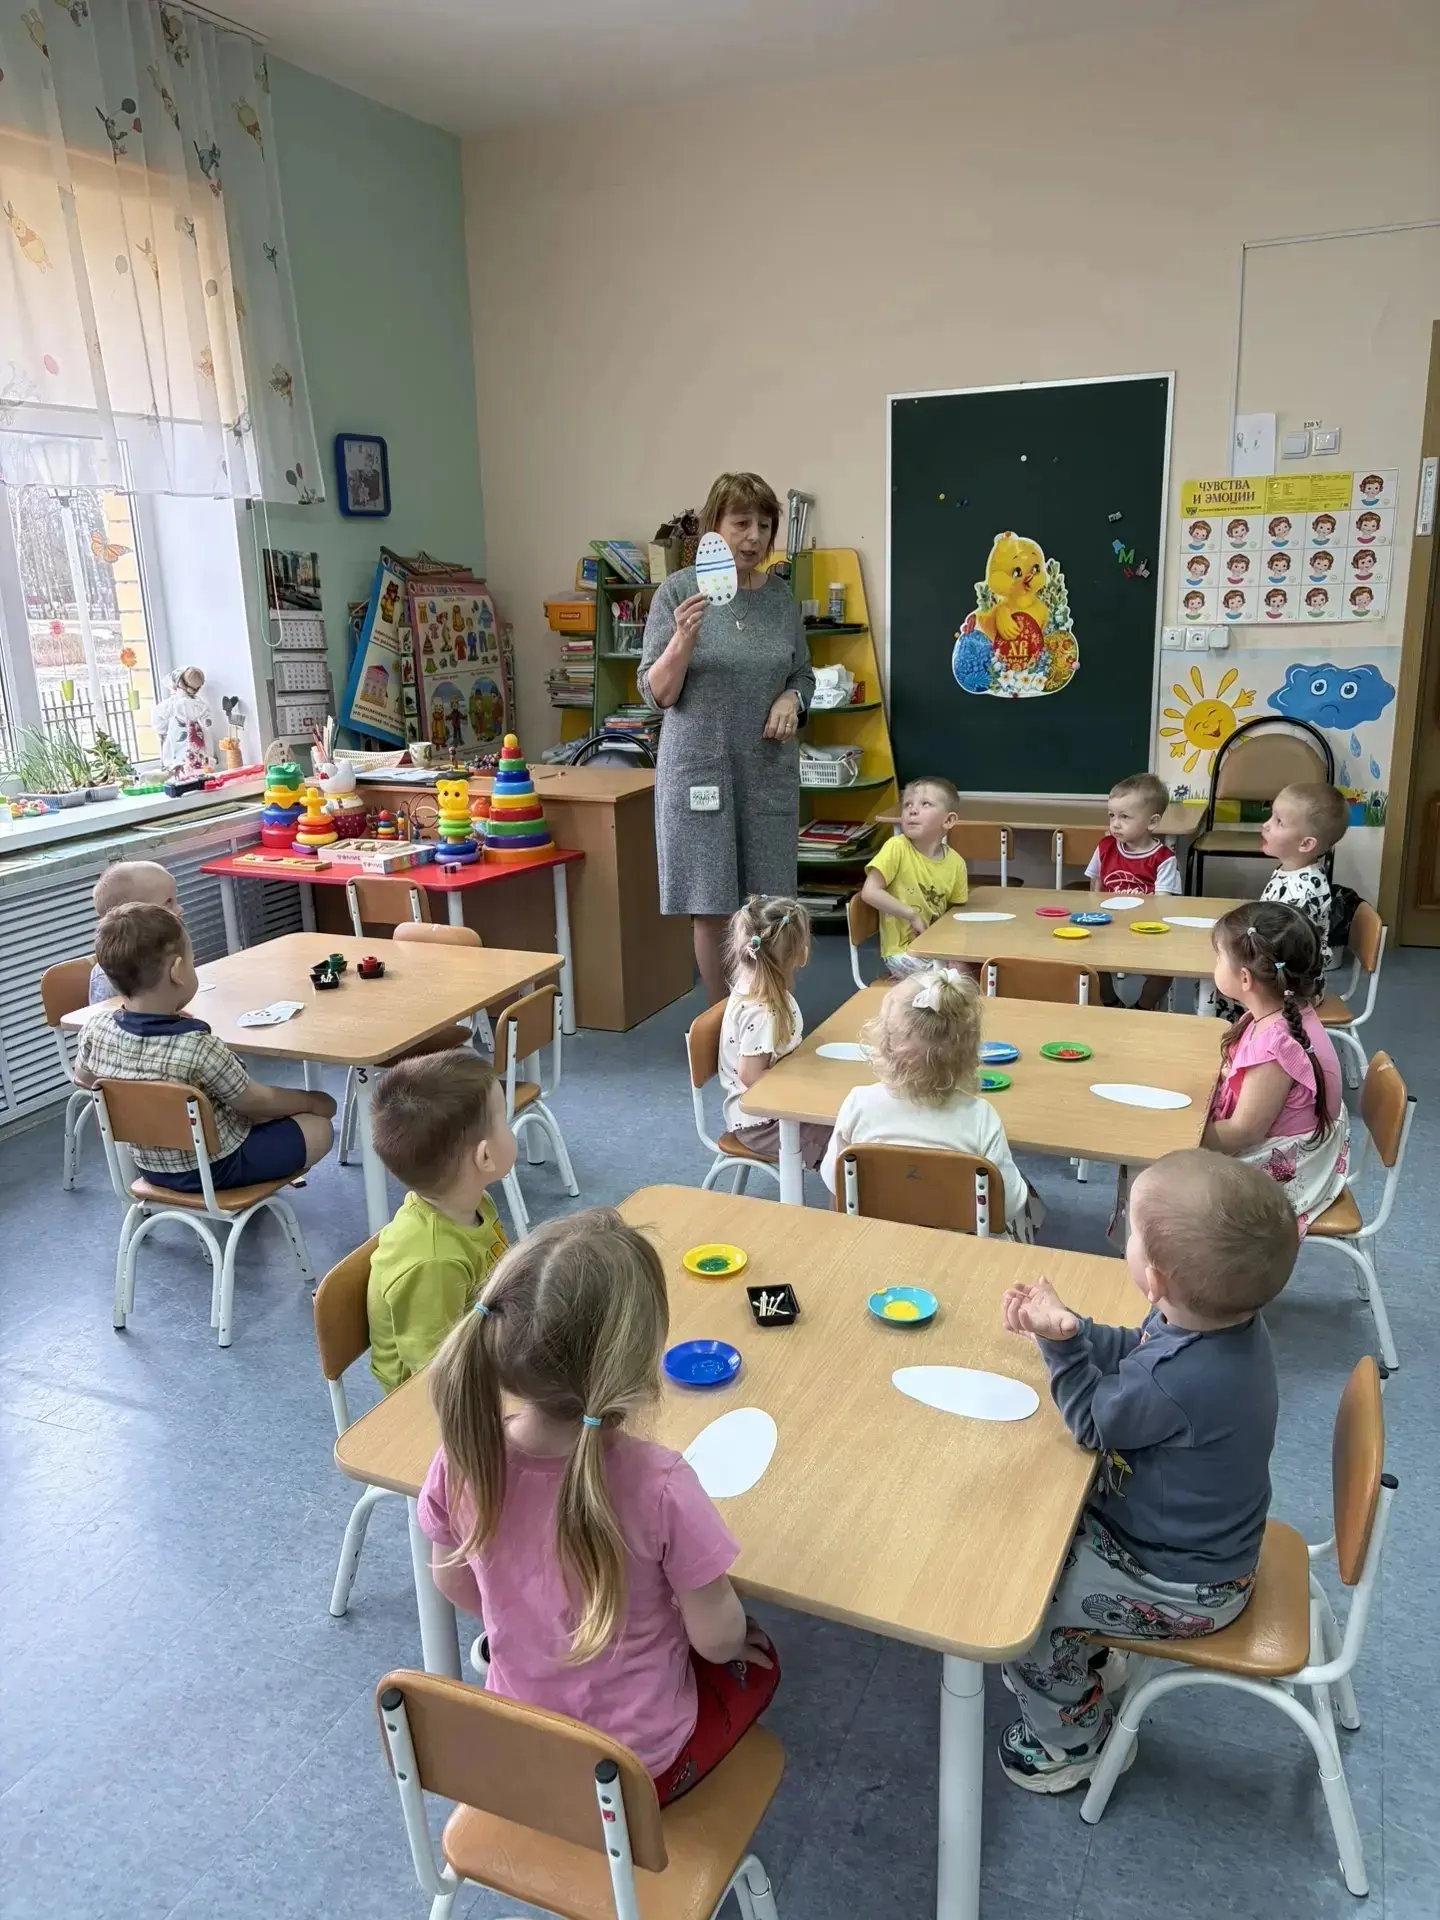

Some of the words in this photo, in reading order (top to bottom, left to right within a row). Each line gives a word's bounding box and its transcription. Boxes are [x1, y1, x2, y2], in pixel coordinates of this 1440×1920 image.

[1199, 480, 1250, 492] ЧУВСТВА
[1193, 494, 1201, 504] И
[1205, 491, 1255, 504] ЭМОЦИИ
[356, 1067, 369, 1084] 3
[906, 1164, 924, 1180] 2
